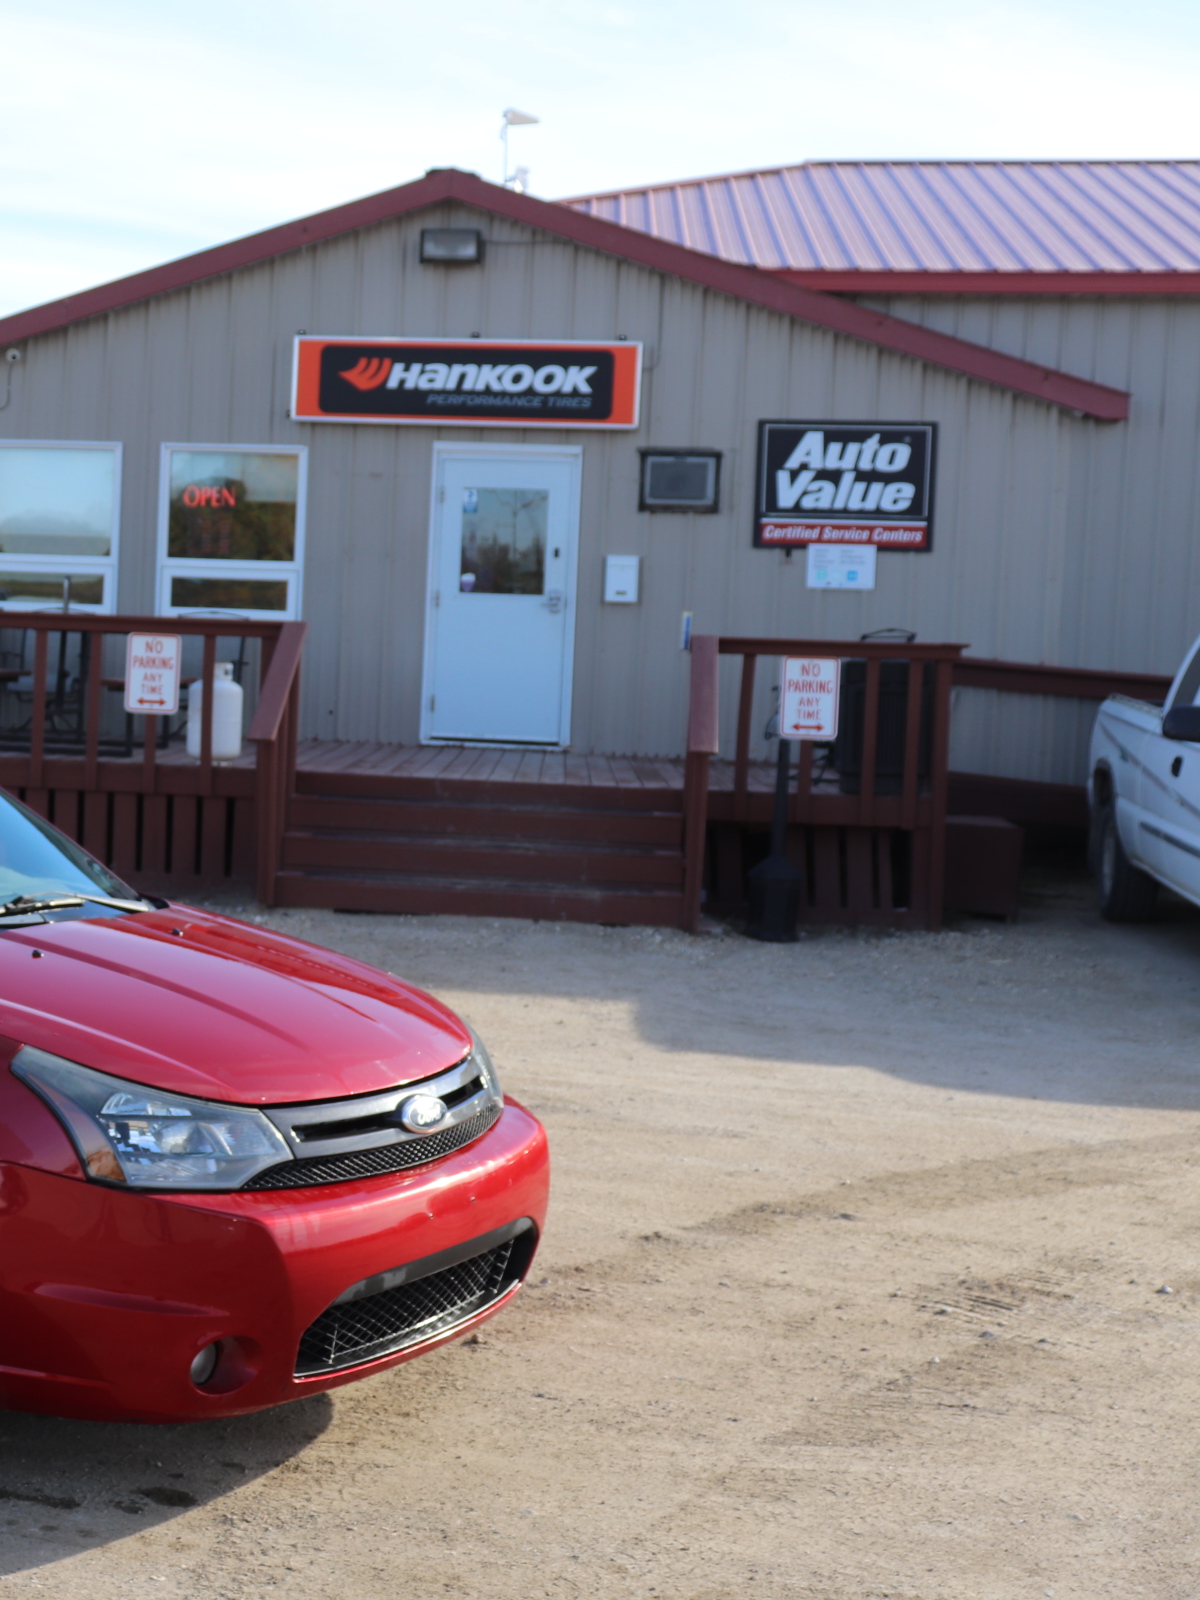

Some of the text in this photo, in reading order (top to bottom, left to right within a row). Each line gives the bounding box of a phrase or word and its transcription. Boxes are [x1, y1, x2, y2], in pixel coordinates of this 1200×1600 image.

[426, 393, 593, 409] PERFORMANCE TIRES
[783, 430, 912, 473] Auto
[183, 484, 236, 508] OPEN
[775, 469, 916, 513] Value
[764, 525, 923, 543] Certified Service Centers
[145, 640, 163, 654] NO
[133, 655, 174, 670] PARKING
[801, 663, 821, 677] NO
[143, 672, 163, 682] ANY
[141, 684, 164, 695] TIME
[788, 679, 833, 694] PARKING
[798, 696, 821, 707] ANY
[796, 709, 822, 720] TIME
